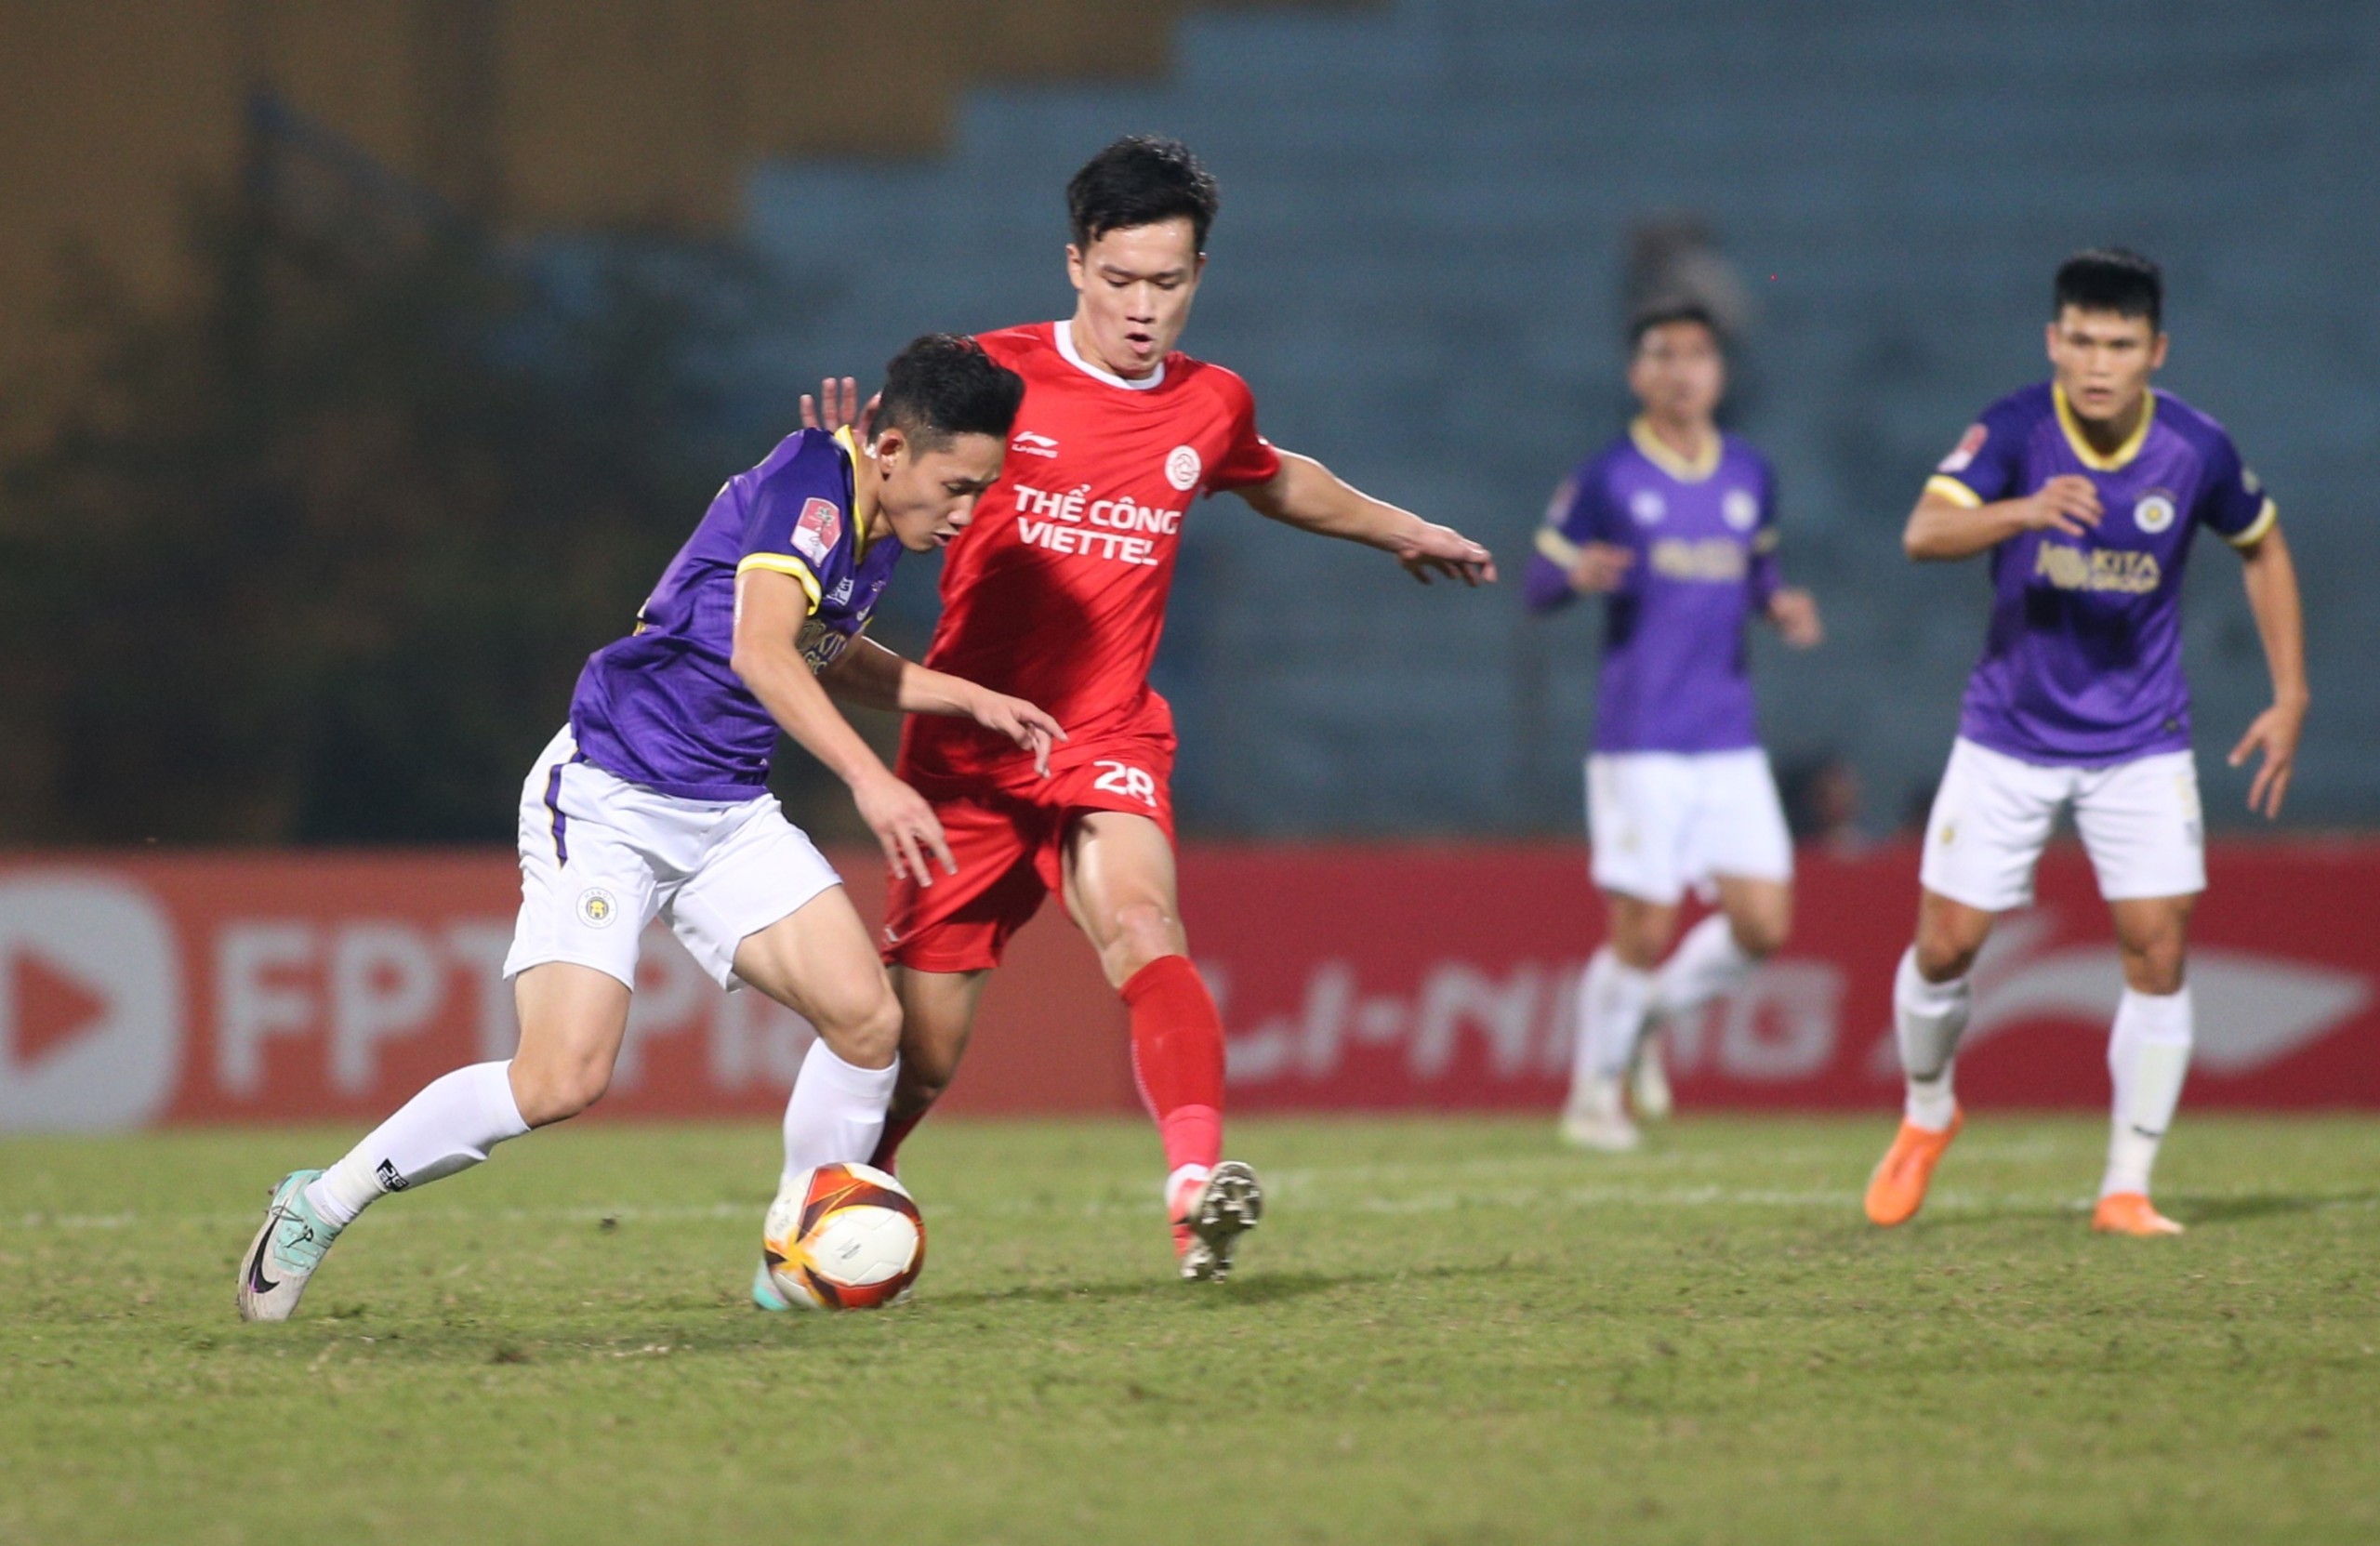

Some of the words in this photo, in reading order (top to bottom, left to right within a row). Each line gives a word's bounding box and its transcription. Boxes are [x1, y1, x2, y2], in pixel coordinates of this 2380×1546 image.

[1013, 484, 1091, 522] THỂ
[1089, 496, 1182, 535] CÔNG
[1017, 517, 1158, 566] VIETTEL
[1092, 760, 1157, 807] 28
[209, 920, 517, 1100] FPT
[1204, 960, 1848, 1083] LI-NIG
